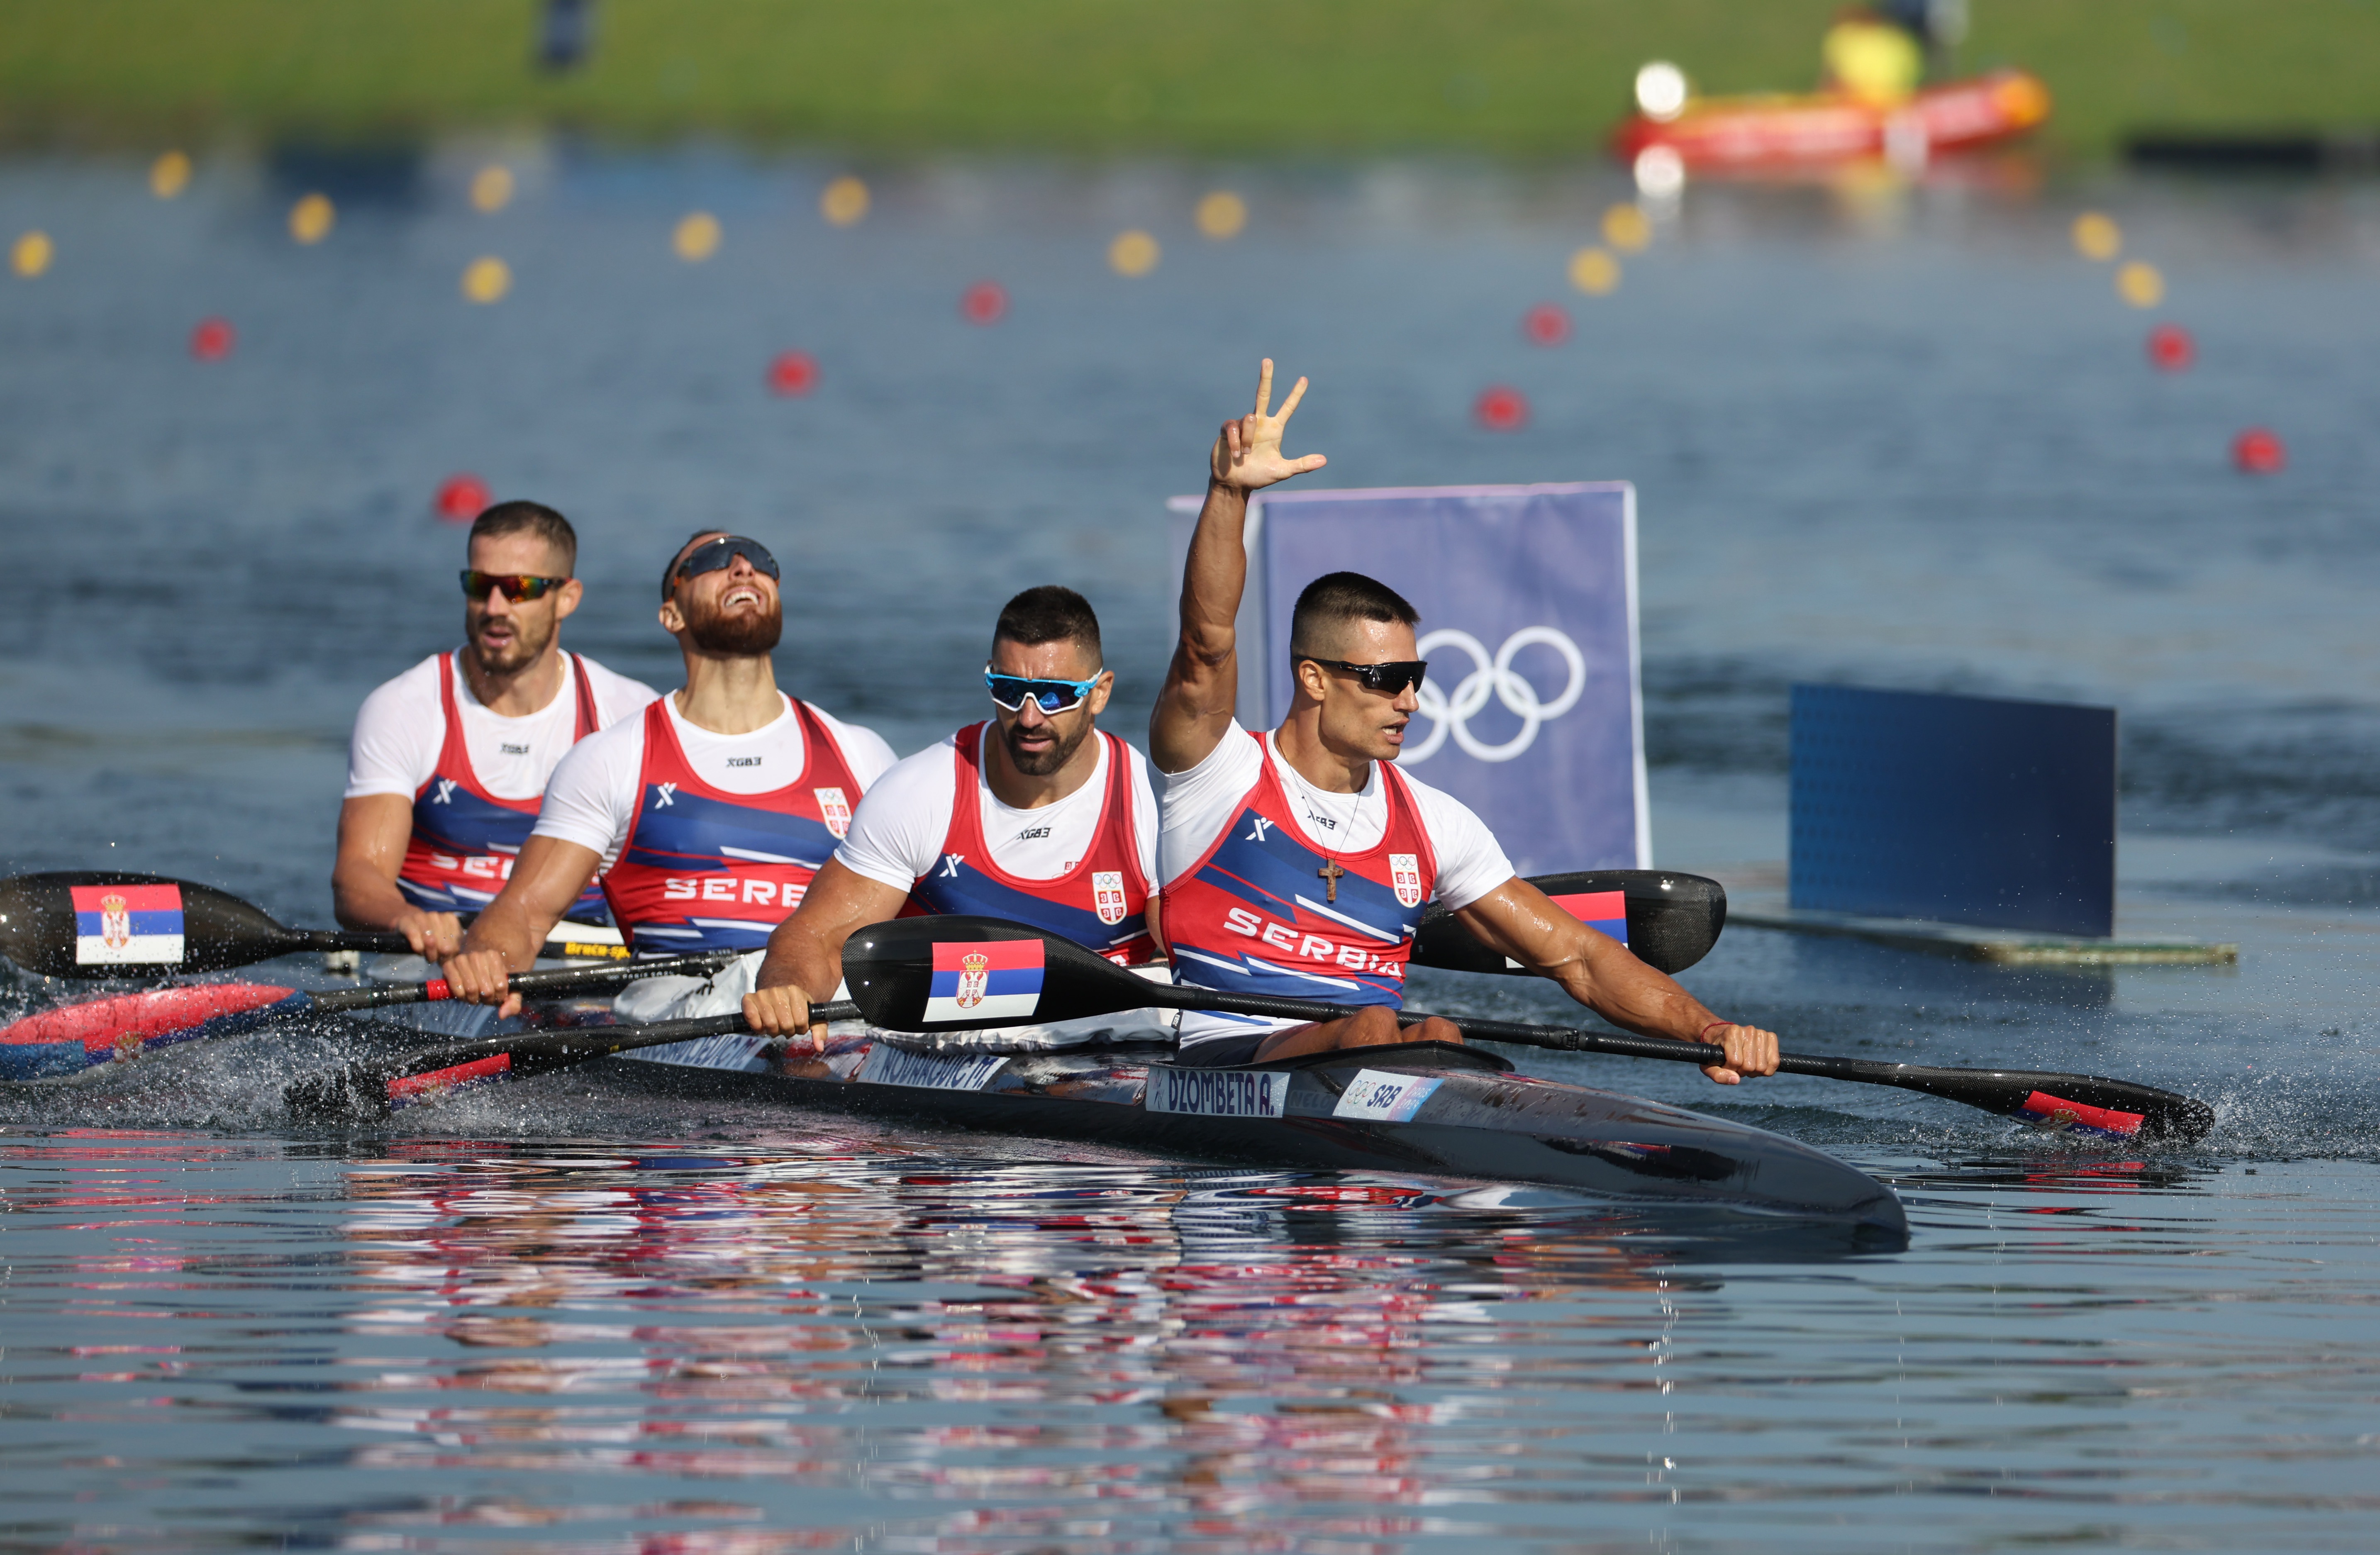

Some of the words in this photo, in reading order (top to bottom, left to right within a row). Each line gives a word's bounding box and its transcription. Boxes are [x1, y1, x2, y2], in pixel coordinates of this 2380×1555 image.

[1224, 907, 1402, 978] SERBIA
[1169, 1070, 1255, 1115] DZOMBETA
[1259, 1073, 1274, 1116] A.
[1290, 1091, 1332, 1109] NELO
[1367, 1084, 1403, 1108] SRB
[1407, 1087, 1431, 1098] PARIS
[1397, 1099, 1419, 1109] 2024
